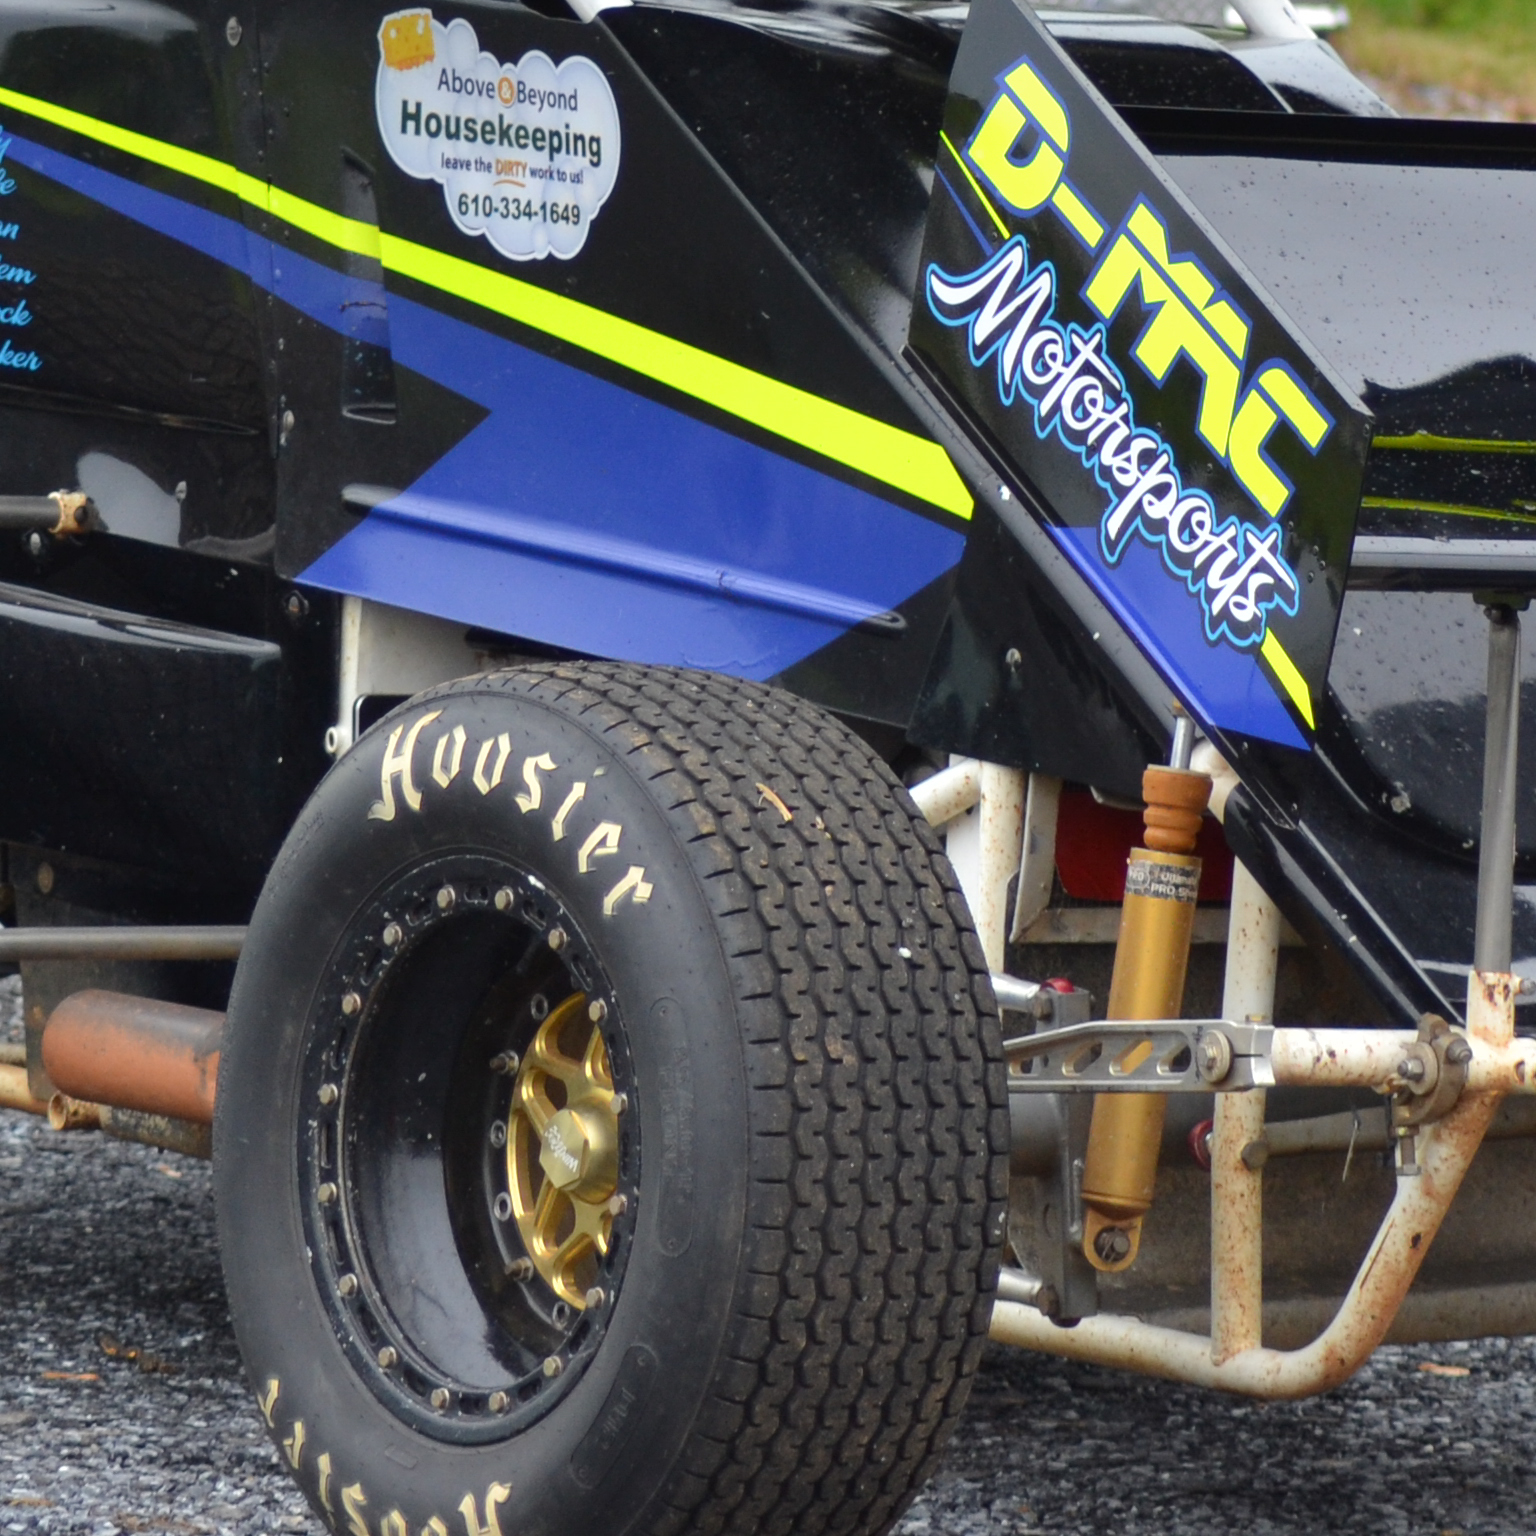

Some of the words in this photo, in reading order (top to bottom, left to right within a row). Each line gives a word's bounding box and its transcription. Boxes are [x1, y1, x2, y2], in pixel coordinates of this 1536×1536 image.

[437, 68, 496, 100] Above
[516, 80, 579, 112] Beyond
[400, 99, 602, 168] Housekeeping
[441, 152, 472, 171] leave
[474, 156, 493, 173] the
[495, 159, 528, 178] DIRTY
[529, 164, 555, 181] work
[556, 165, 568, 183] to
[569, 167, 585, 185] us!
[458, 192, 582, 227] 610-334-1649
[927, 236, 1298, 629] Motorsports
[367, 709, 654, 916] Hoosier
